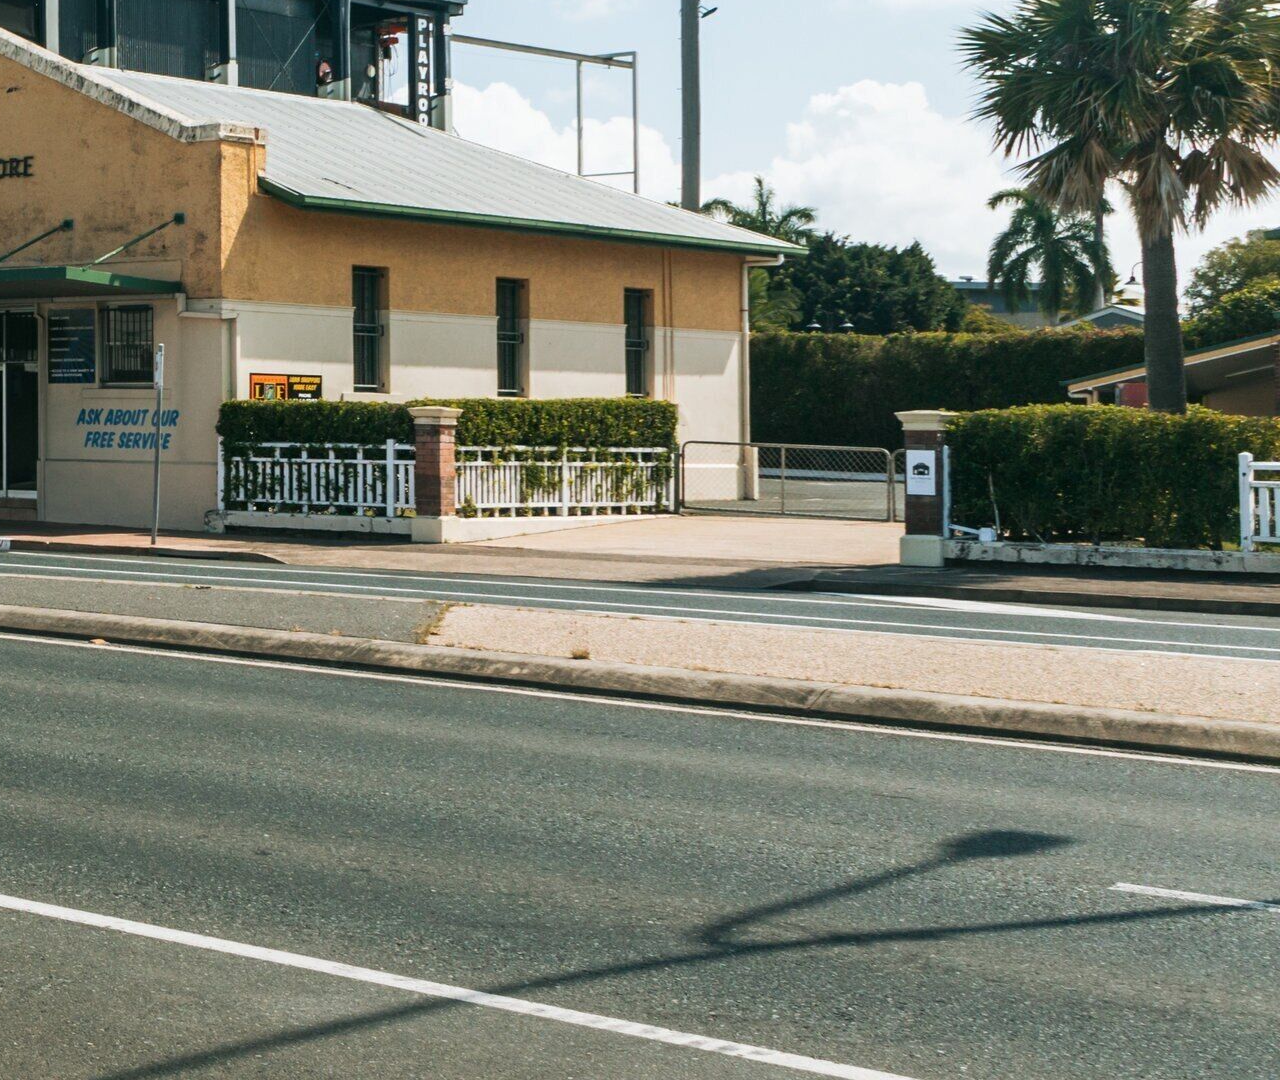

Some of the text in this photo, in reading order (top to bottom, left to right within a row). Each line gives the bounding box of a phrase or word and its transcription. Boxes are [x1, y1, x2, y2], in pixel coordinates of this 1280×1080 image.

[77, 408, 179, 427] ASK ABOUT OUR
[84, 431, 116, 449] FREE
